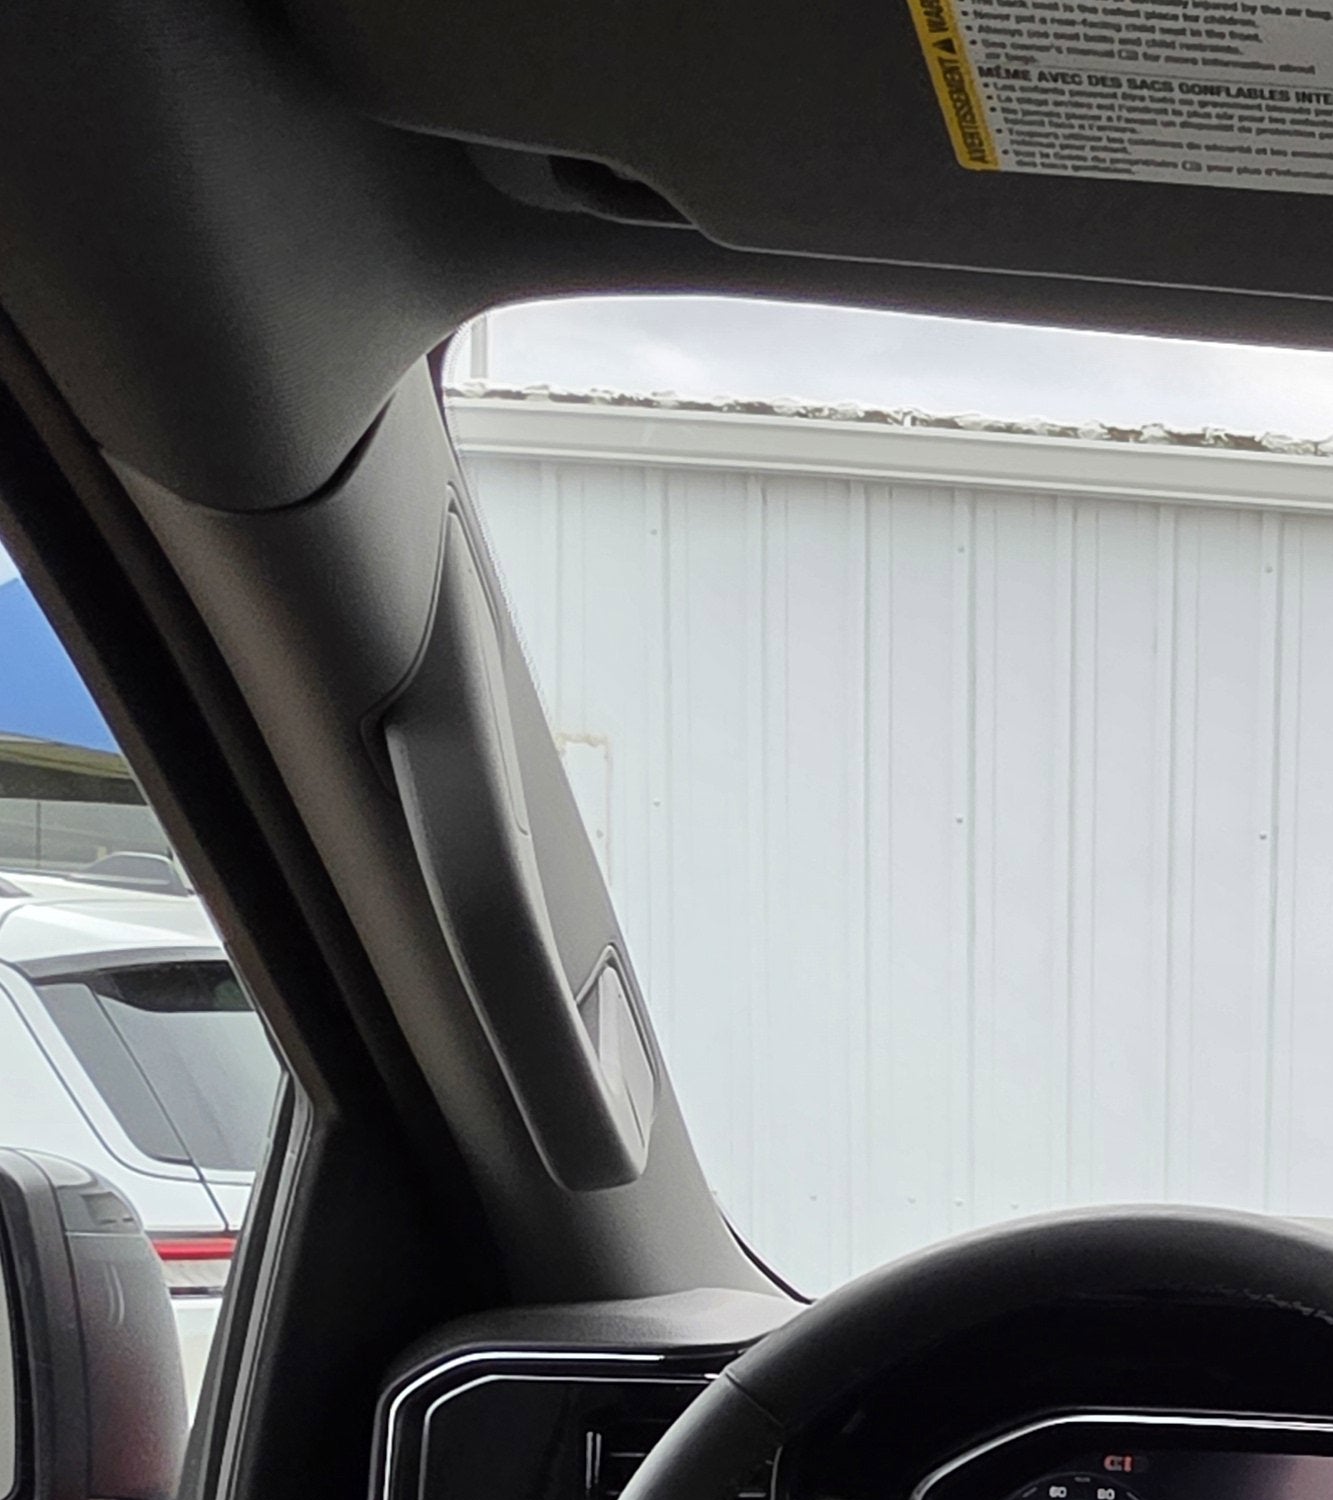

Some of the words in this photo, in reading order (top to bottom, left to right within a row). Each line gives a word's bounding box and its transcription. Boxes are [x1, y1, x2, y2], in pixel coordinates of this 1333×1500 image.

[1036, 70, 1084, 86] AVEC
[1086, 74, 1123, 89] DES
[1125, 77, 1175, 93] SACS
[1177, 81, 1291, 102] GONFLABLES
[1049, 1486, 1067, 1498] 60
[1097, 1488, 1115, 1500] 80
